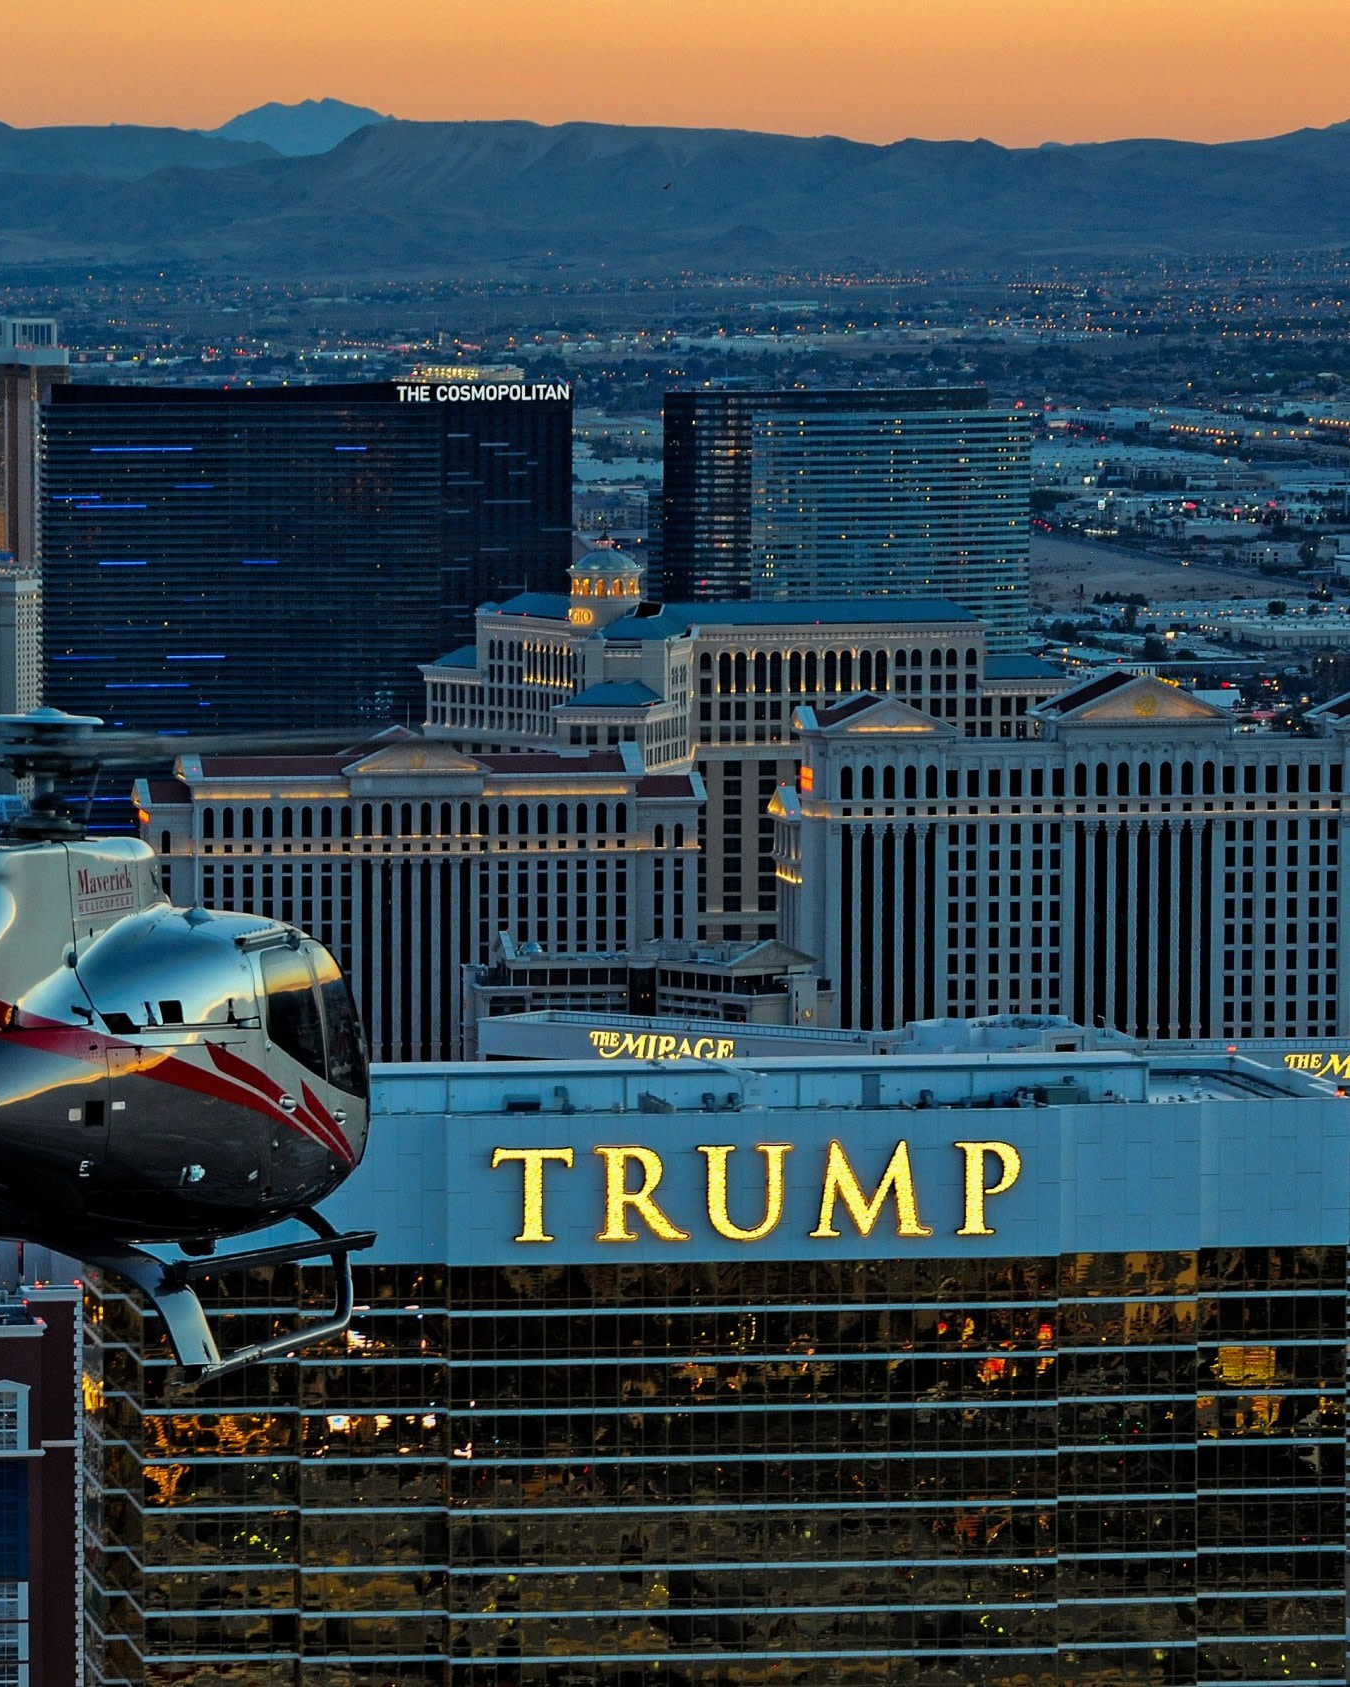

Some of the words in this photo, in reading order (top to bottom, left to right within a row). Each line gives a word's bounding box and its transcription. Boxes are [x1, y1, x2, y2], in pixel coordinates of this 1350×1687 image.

[396, 385, 431, 402] THE
[435, 384, 570, 402] COSMOPOLITAN
[77, 864, 132, 895] Maverick
[590, 1031, 620, 1048] THE
[600, 1034, 736, 1060] MIRAGE
[1284, 1053, 1323, 1070] THE
[491, 1140, 1022, 1244] TRUMP
